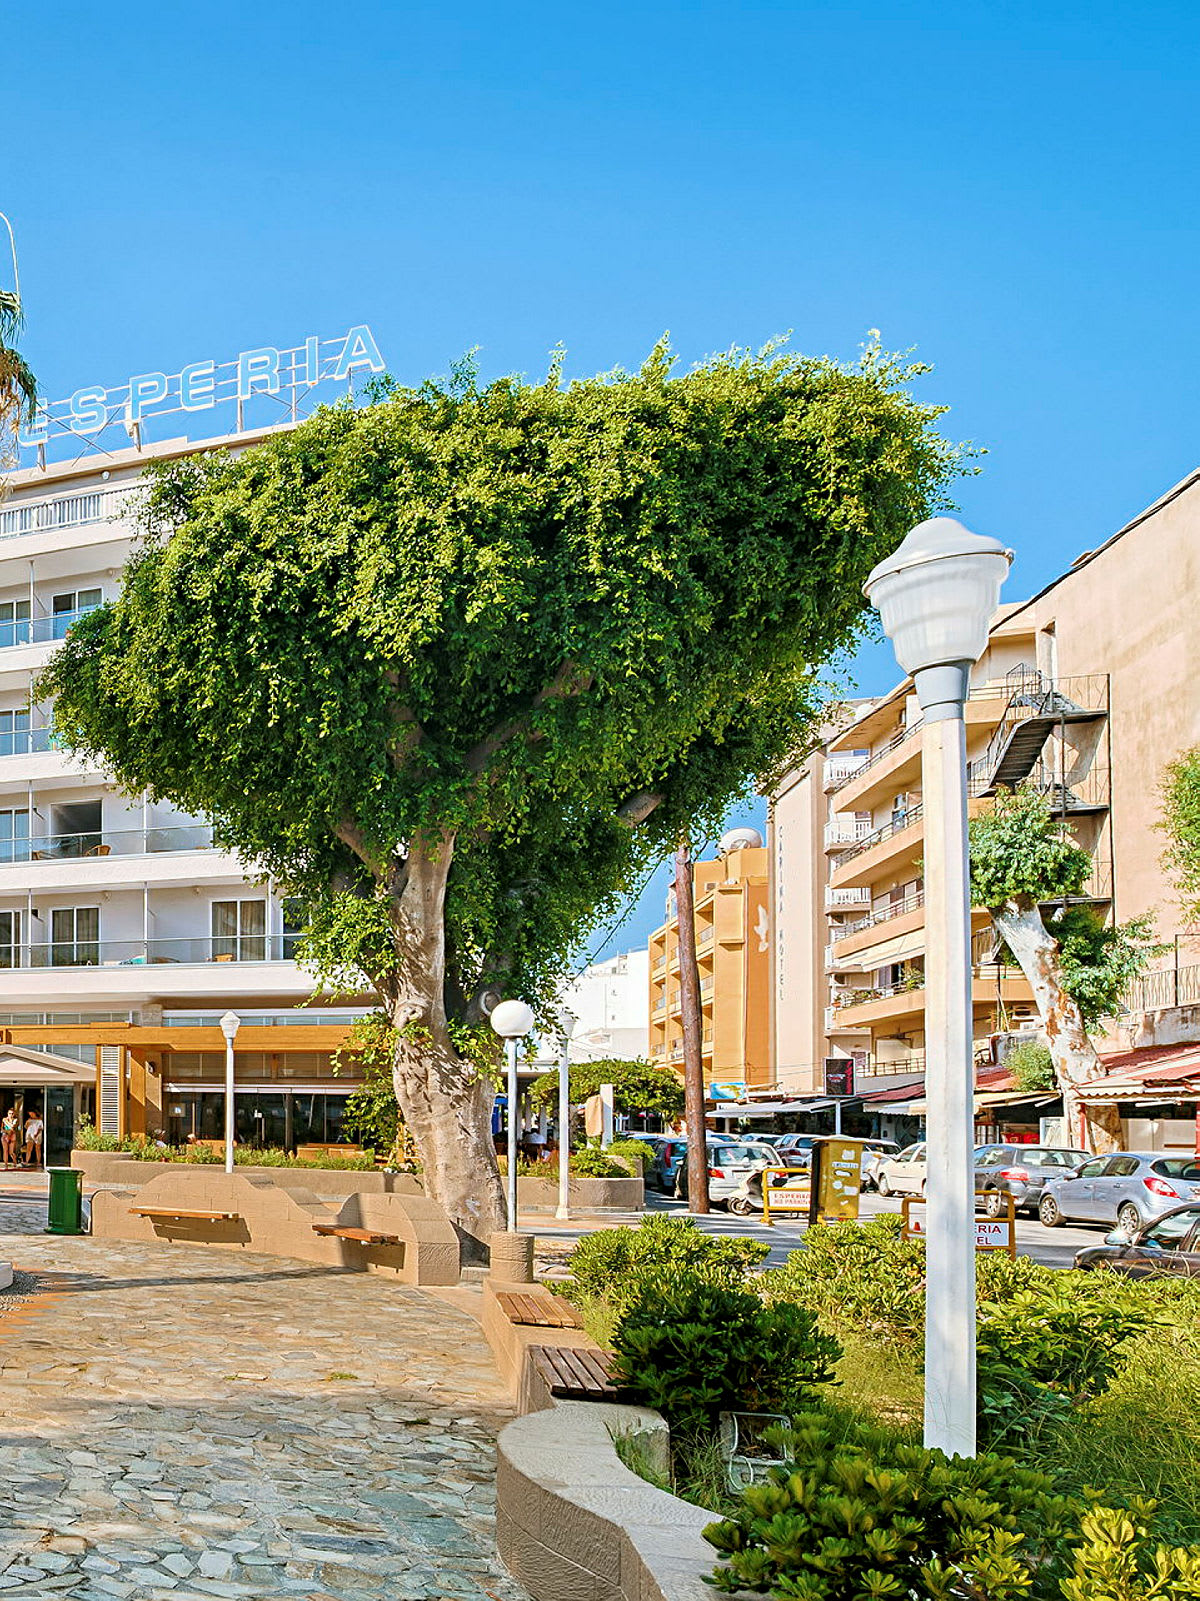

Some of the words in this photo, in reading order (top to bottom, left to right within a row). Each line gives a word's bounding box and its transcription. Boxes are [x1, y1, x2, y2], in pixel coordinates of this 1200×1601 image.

[17, 324, 386, 447] ESPERIA
[776, 929, 786, 1001] HOTEL
[975, 1236, 992, 1245] EL
